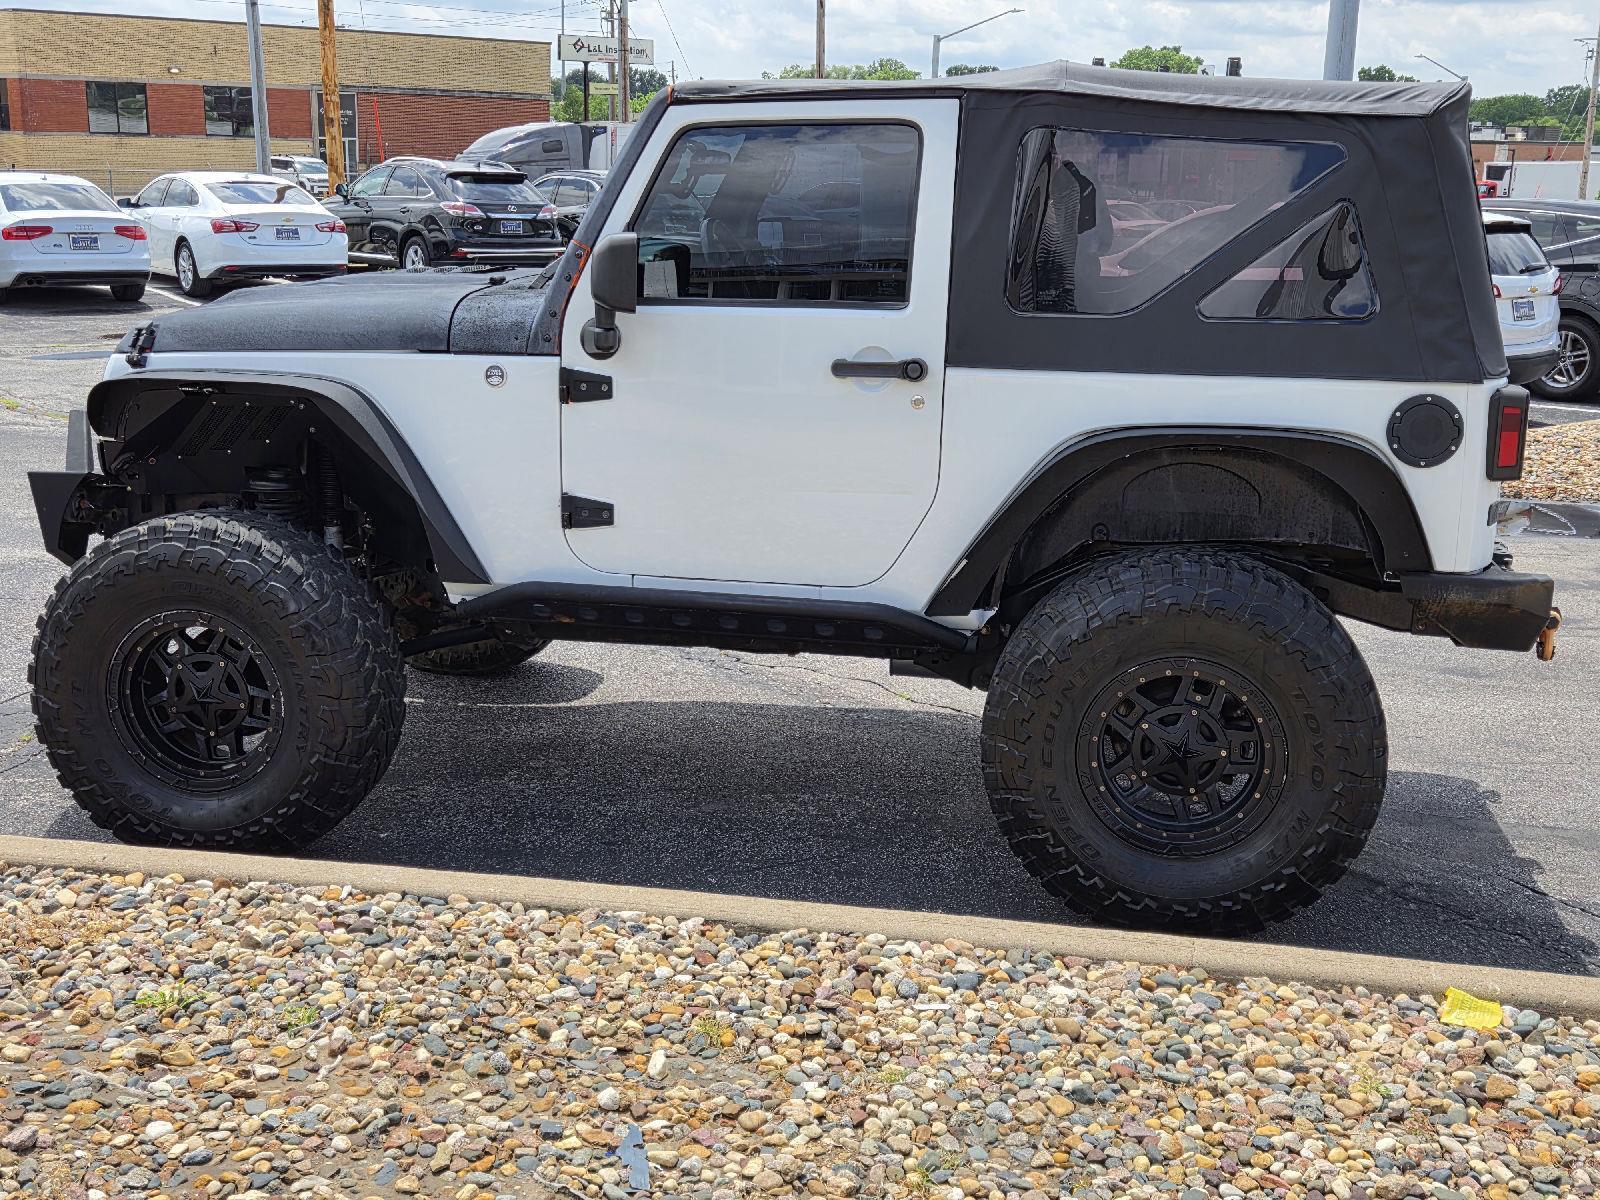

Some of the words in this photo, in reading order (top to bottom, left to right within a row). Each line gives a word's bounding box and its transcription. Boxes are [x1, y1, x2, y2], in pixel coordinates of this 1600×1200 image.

[587, 43, 603, 53] L&L
[1288, 685, 1326, 792] TOYO
[1041, 784, 1103, 863] OPEN
[1264, 809, 1312, 869] M/T
